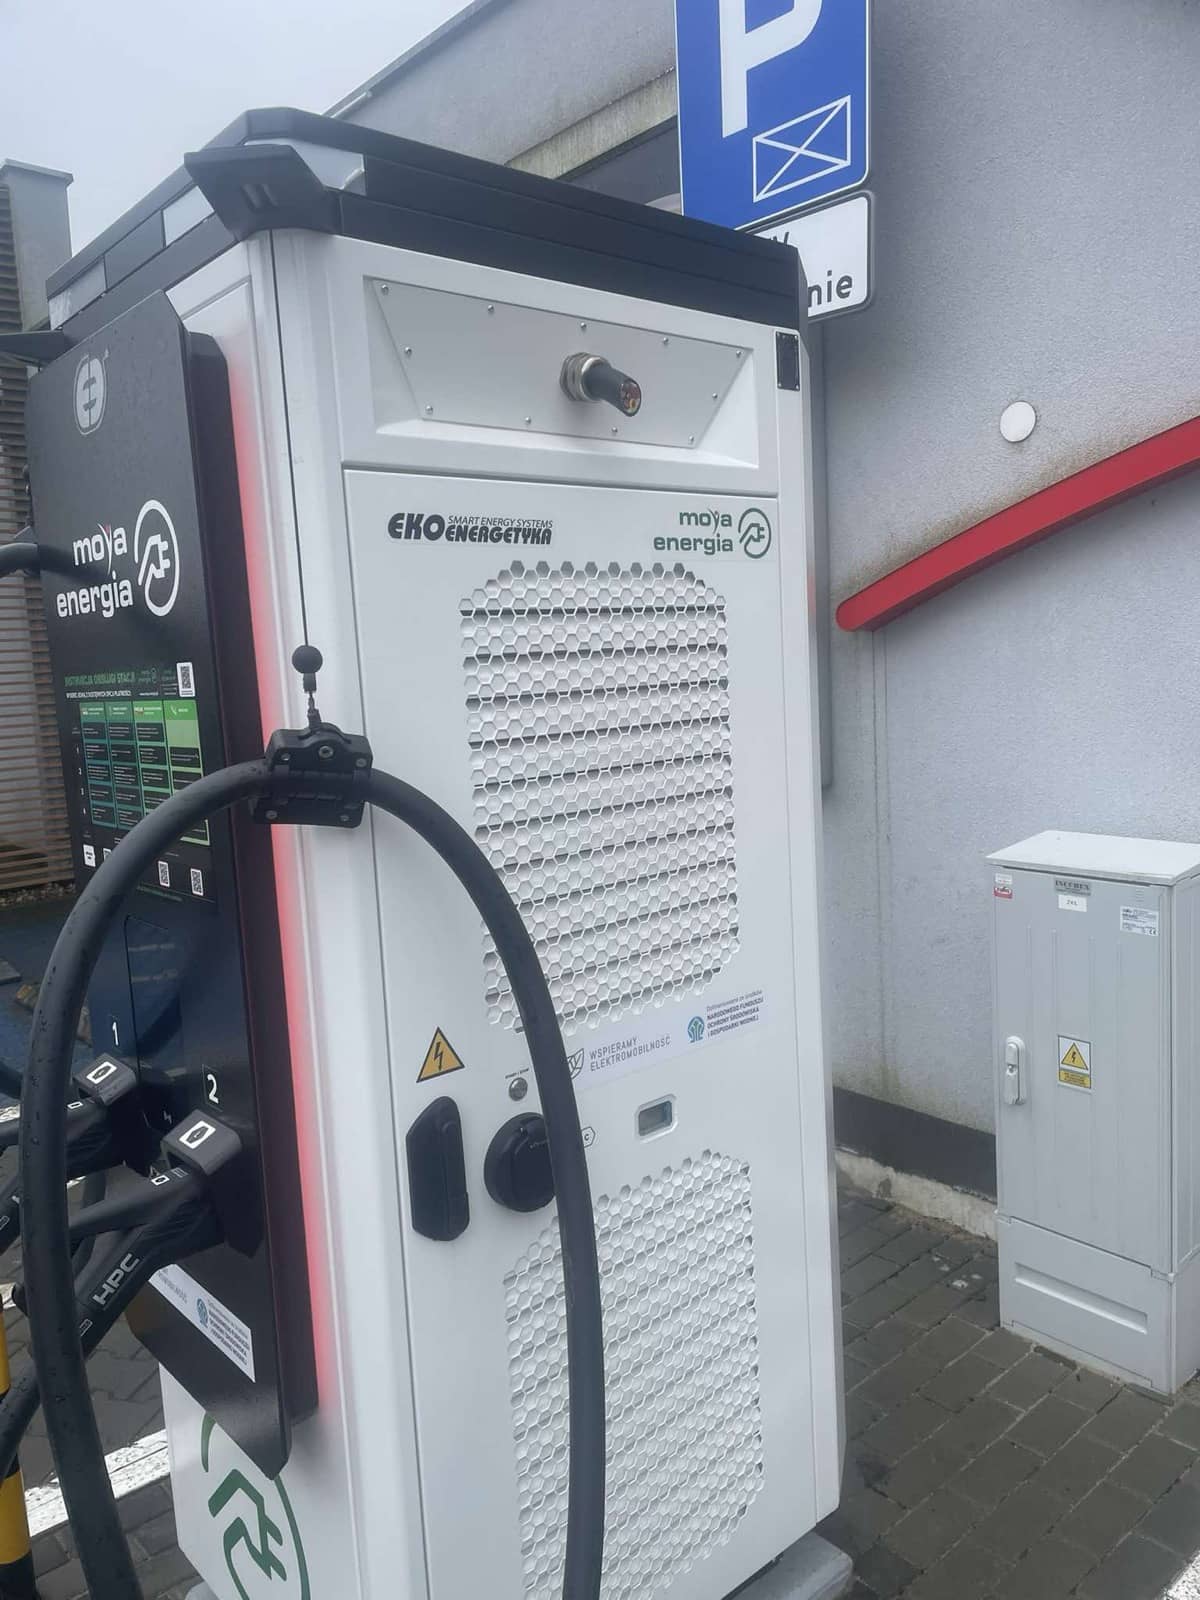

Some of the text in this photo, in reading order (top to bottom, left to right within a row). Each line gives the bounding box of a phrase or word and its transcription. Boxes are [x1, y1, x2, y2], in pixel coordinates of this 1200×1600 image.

[719, 0, 823, 138] P
[448, 515, 553, 528] SMART ENERGY SYSTEMS
[679, 507, 732, 534] moya
[73, 523, 127, 575] moya
[653, 533, 733, 555] energia
[56, 570, 133, 618] energia
[112, 1021, 119, 1045] 1
[589, 1036, 637, 1060] WSPIERAMY
[207, 1074, 219, 1104] 2
[92, 1253, 140, 1304] HPC
